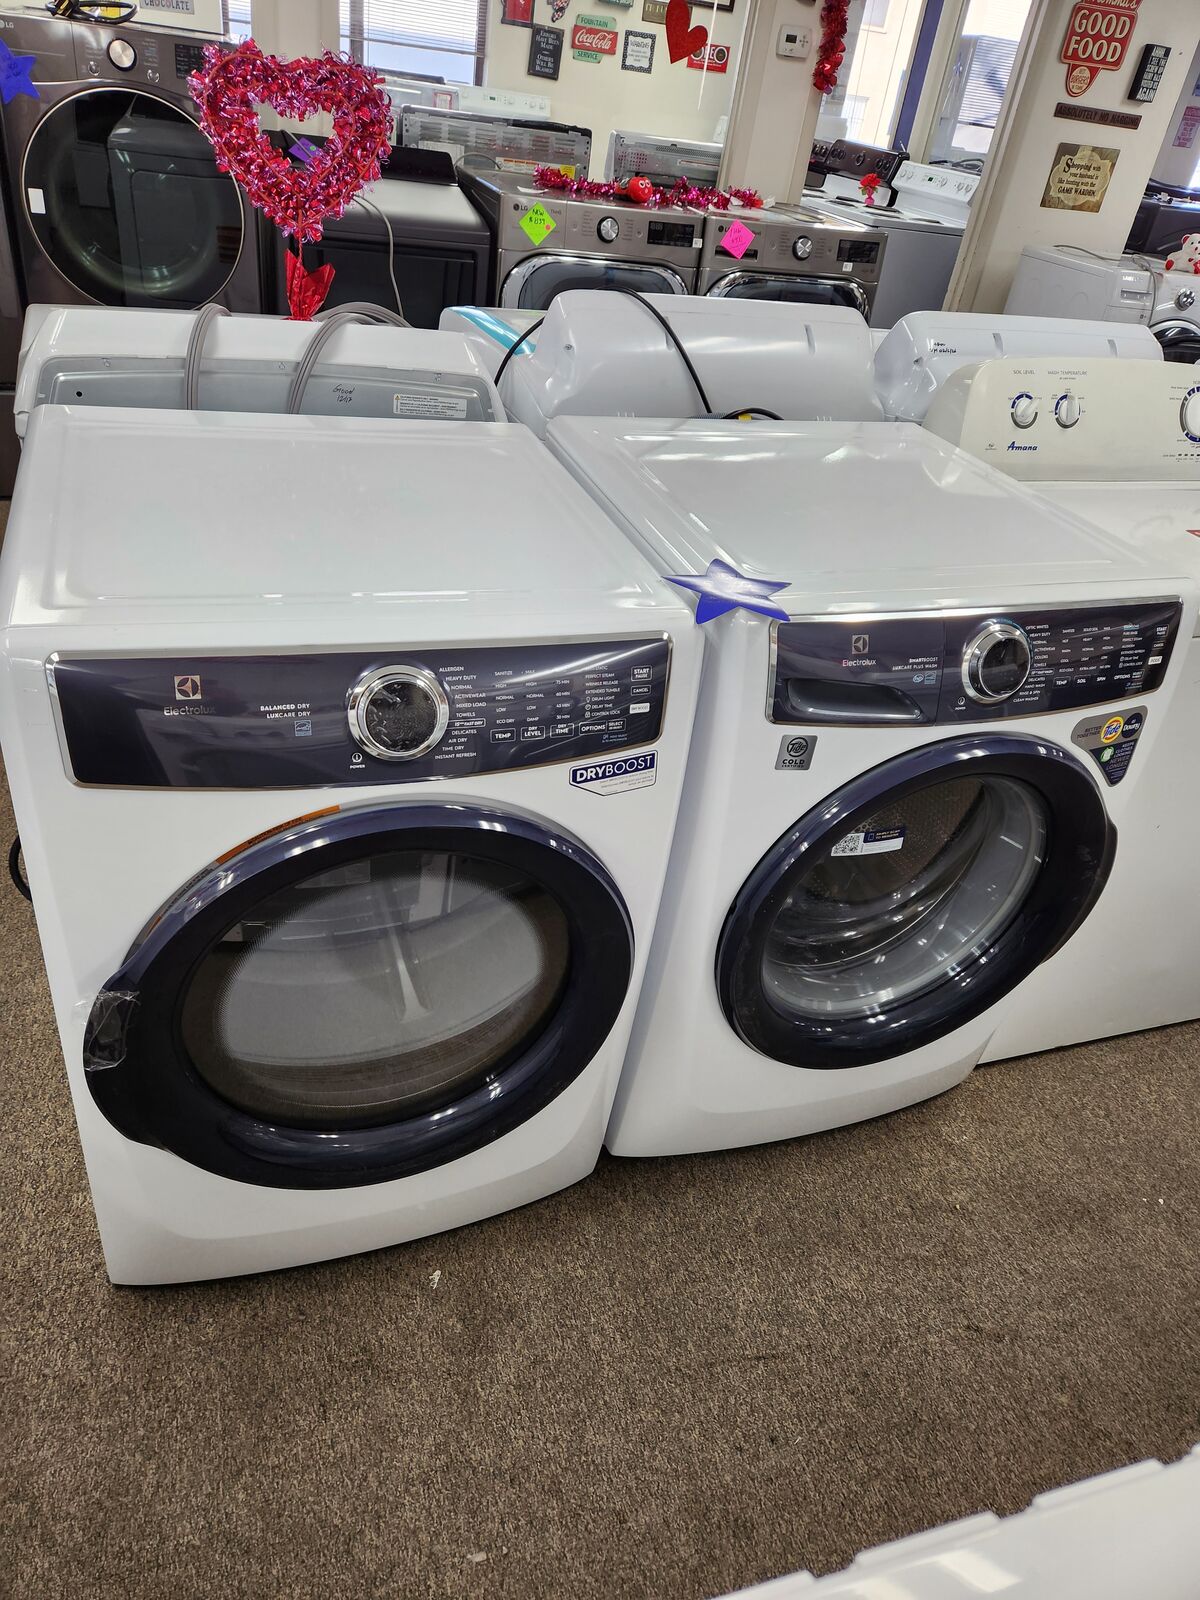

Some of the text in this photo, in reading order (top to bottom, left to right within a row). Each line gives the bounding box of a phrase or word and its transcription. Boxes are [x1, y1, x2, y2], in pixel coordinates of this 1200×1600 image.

[144, 0, 190, 11] CHOCOLATE
[5, 21, 14, 29] LG
[580, 17, 609, 28] FOUNTAIN
[1074, 9, 1131, 39] GOOD
[575, 29, 615, 50] Coca-Cola
[1067, 36, 1122, 63] FOOD
[577, 51, 599, 60] SERVICE
[1056, 104, 1097, 121] ABSOLUTELY
[1099, 112, 1109, 122] NO
[1063, 157, 1092, 173] Shopping
[1057, 186, 1073, 194] GAME
[1007, 440, 1038, 451] Amana
[842, 658, 877, 667] Electrolux
[163, 705, 216, 716] Electrolux
[1103, 723, 1122, 739] Tide
[1123, 723, 1140, 732] Downy
[788, 741, 807, 754] Tide
